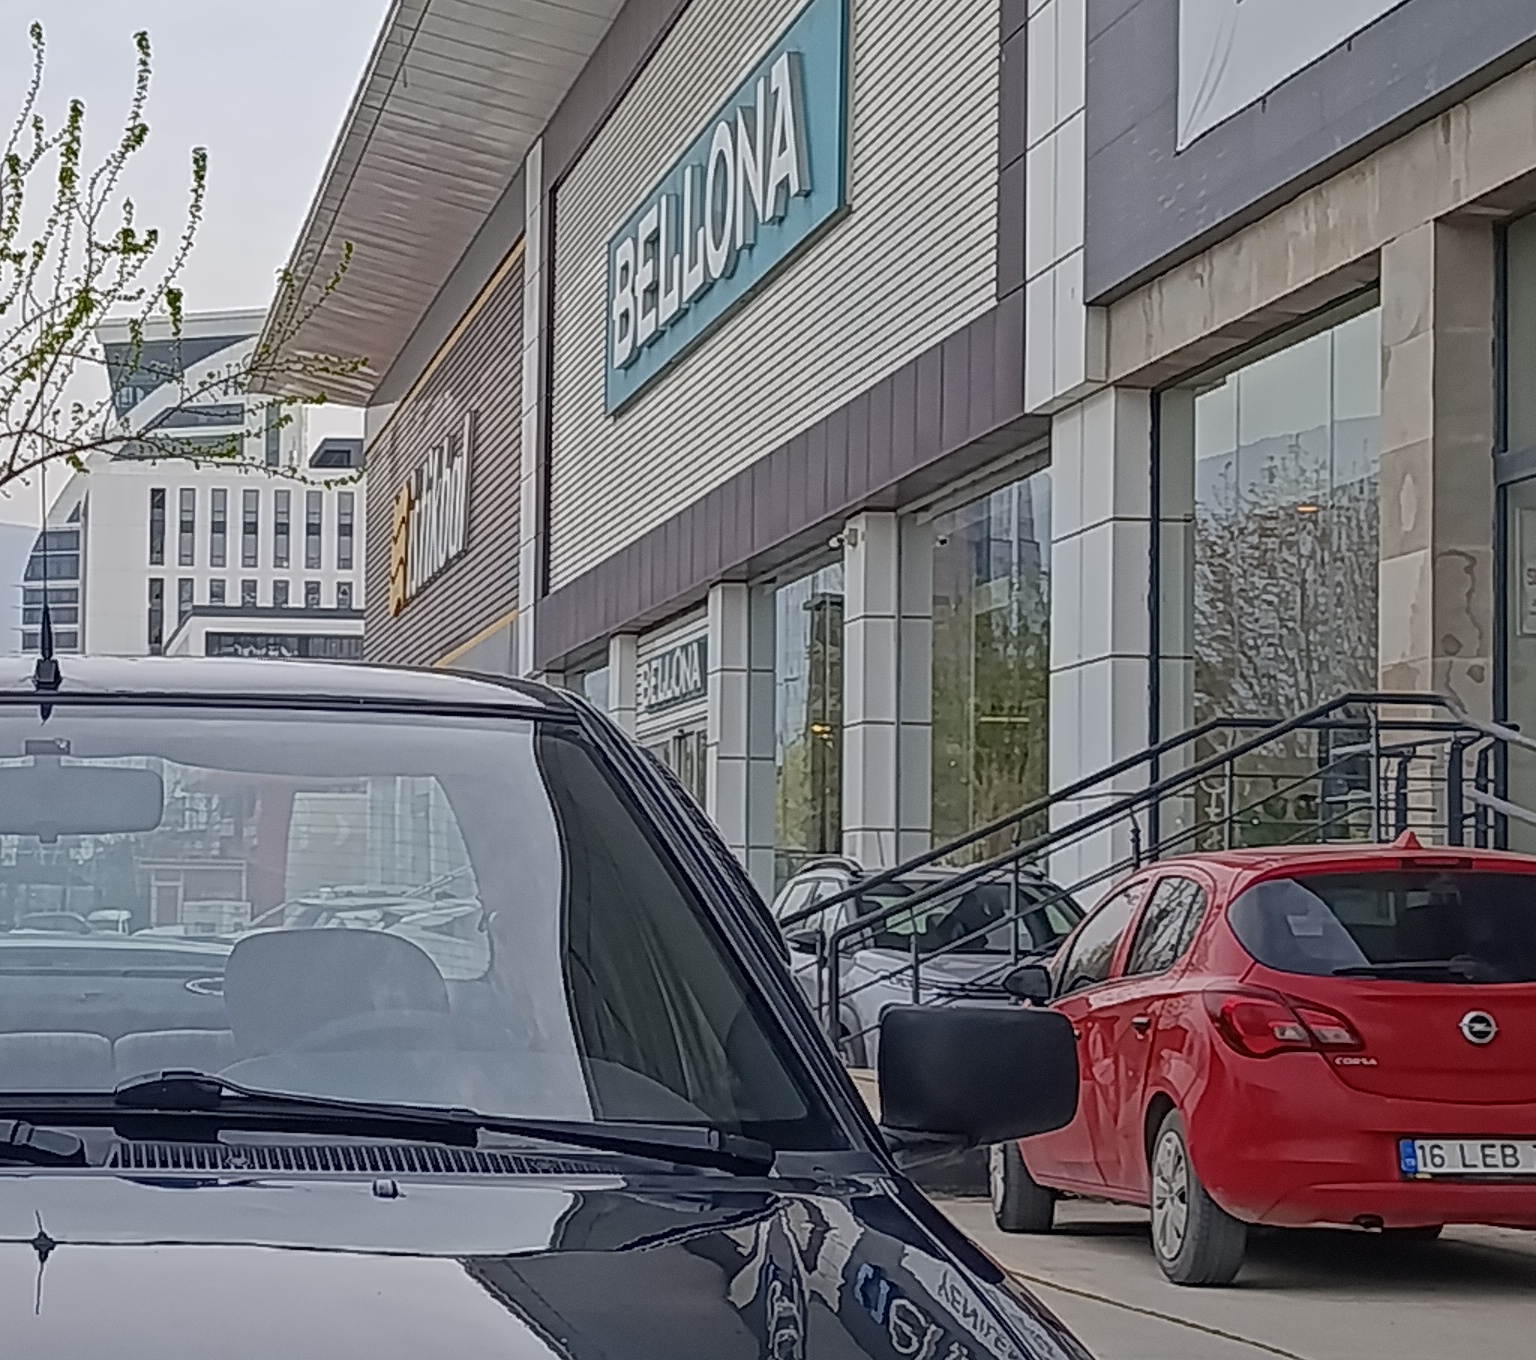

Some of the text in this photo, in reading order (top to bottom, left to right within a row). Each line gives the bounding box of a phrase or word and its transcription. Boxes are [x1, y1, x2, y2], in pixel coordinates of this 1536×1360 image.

[613, 50, 811, 370] BELLONA
[641, 642, 701, 707] BELLONA
[1418, 1144, 1445, 1168] 16
[1459, 1143, 1520, 1168] LEB
